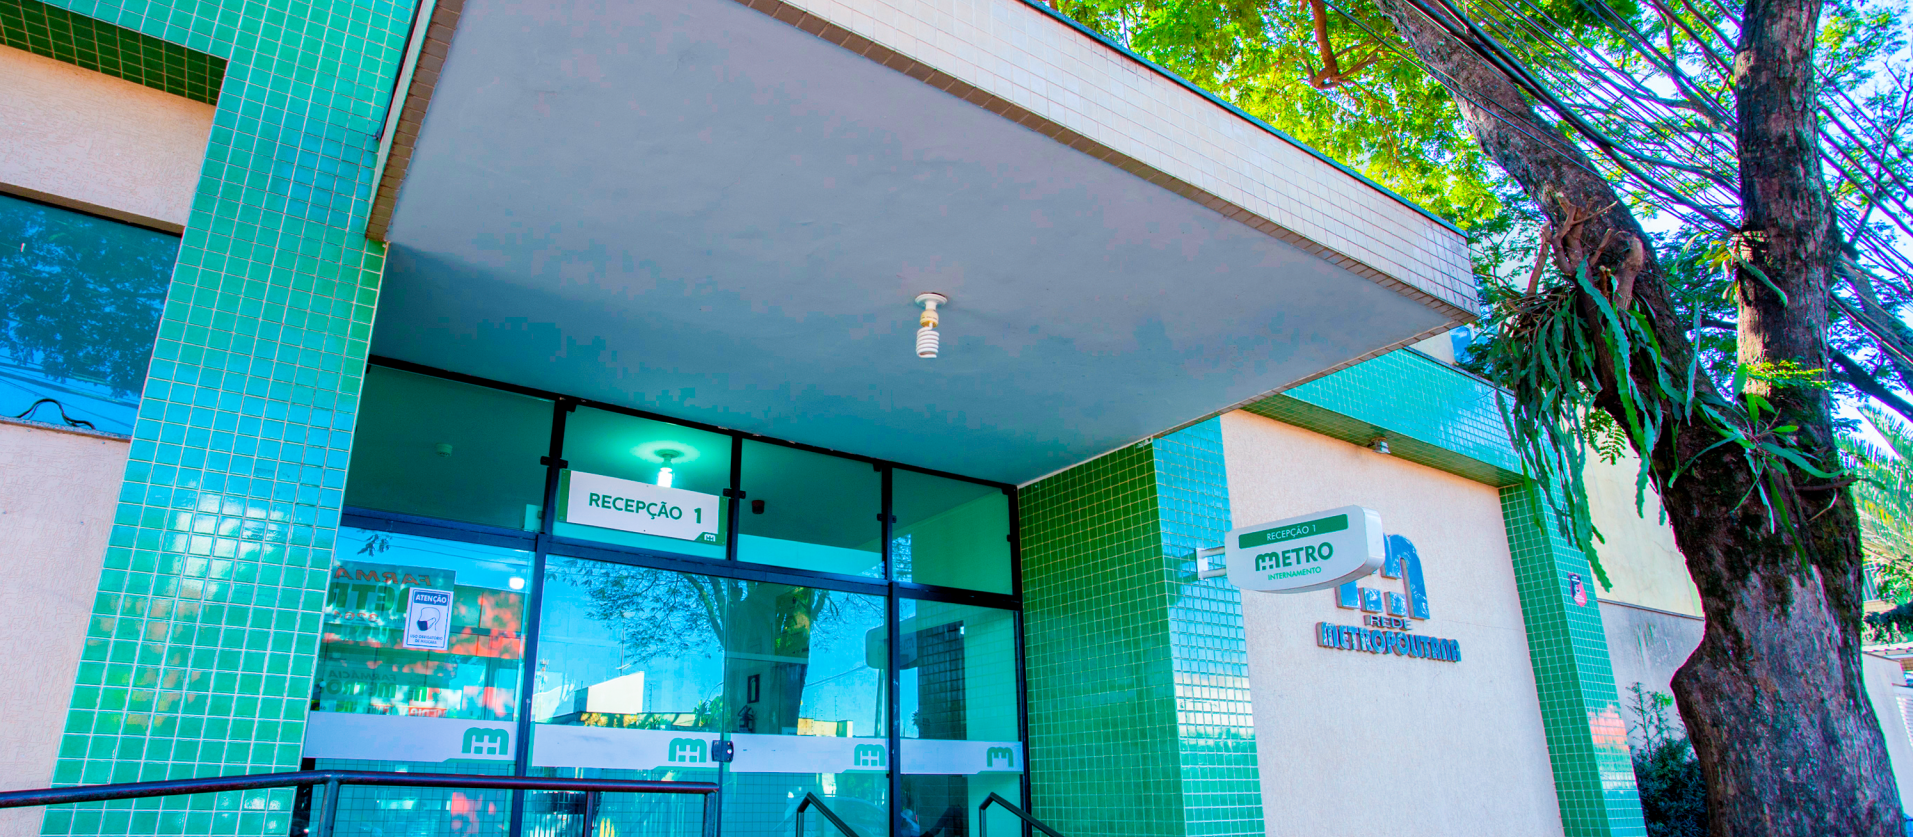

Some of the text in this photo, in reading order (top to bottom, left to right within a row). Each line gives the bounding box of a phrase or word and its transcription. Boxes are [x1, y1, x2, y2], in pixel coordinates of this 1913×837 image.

[588, 492, 702, 524] RECEPÇÃO 1
[1266, 524, 1317, 541] RECEPÇÃO 1
[1255, 541, 1334, 572] METRO
[1267, 566, 1322, 580] INTERNAMENTO
[415, 594, 448, 604] ATENÇÃO
[1364, 614, 1413, 631] REDE
[1315, 621, 1462, 663] METROPOLITANA
